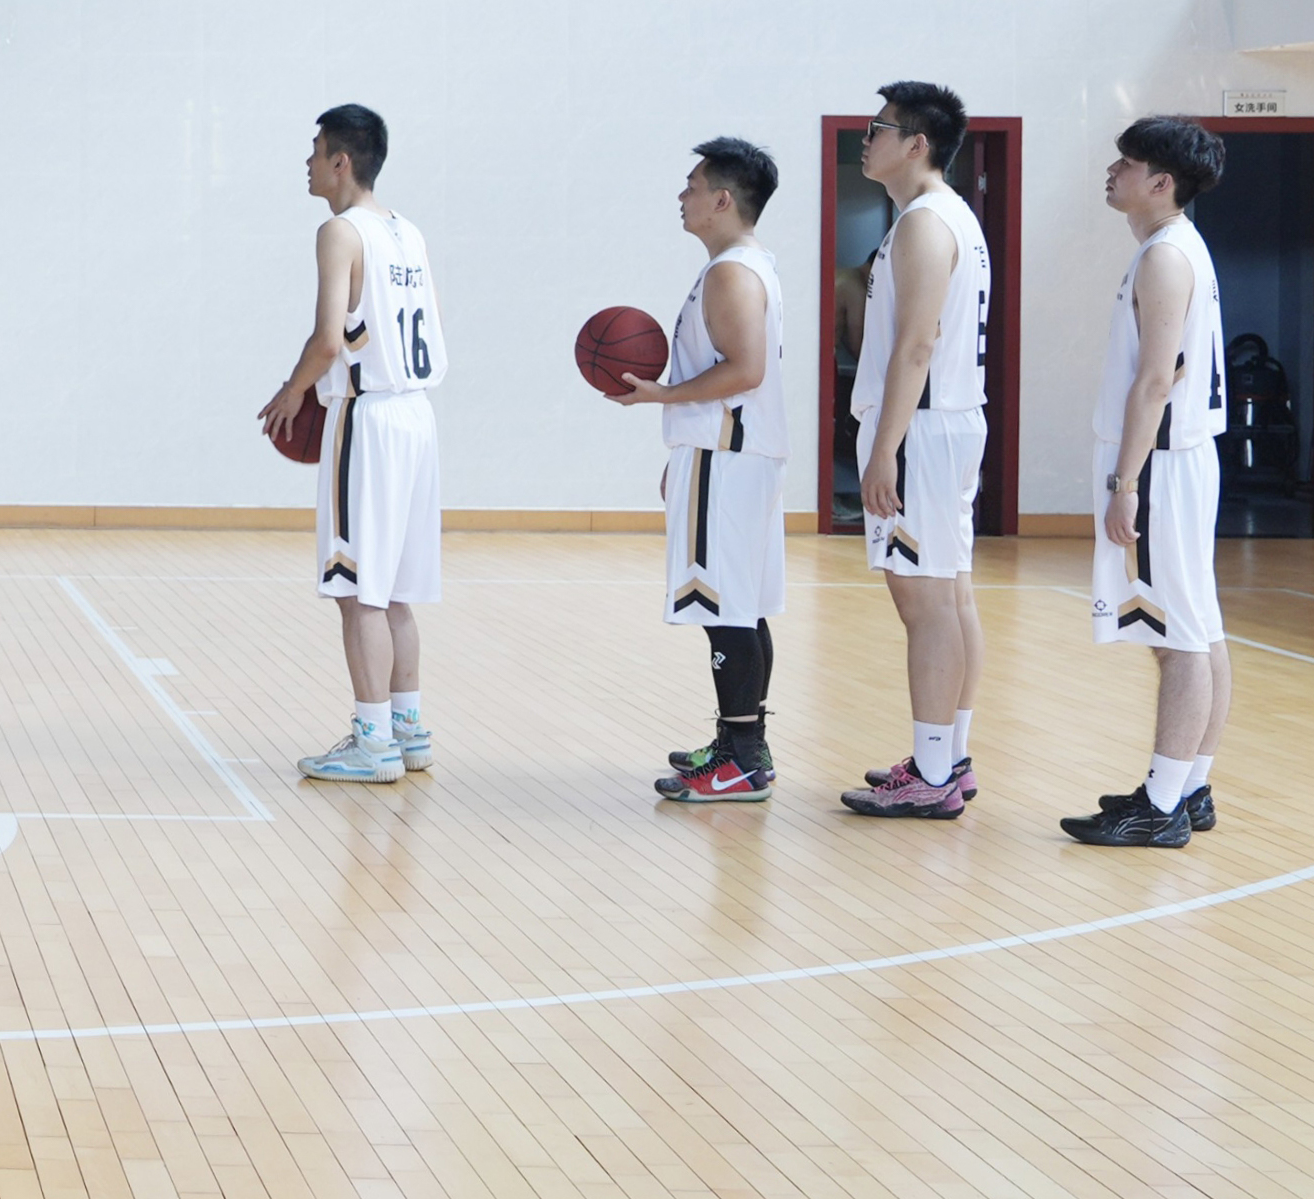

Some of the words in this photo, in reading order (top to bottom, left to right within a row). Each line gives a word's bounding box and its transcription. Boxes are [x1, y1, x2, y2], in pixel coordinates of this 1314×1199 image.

[1234, 103, 1277, 113] 女洗手间
[397, 307, 432, 380] 16
